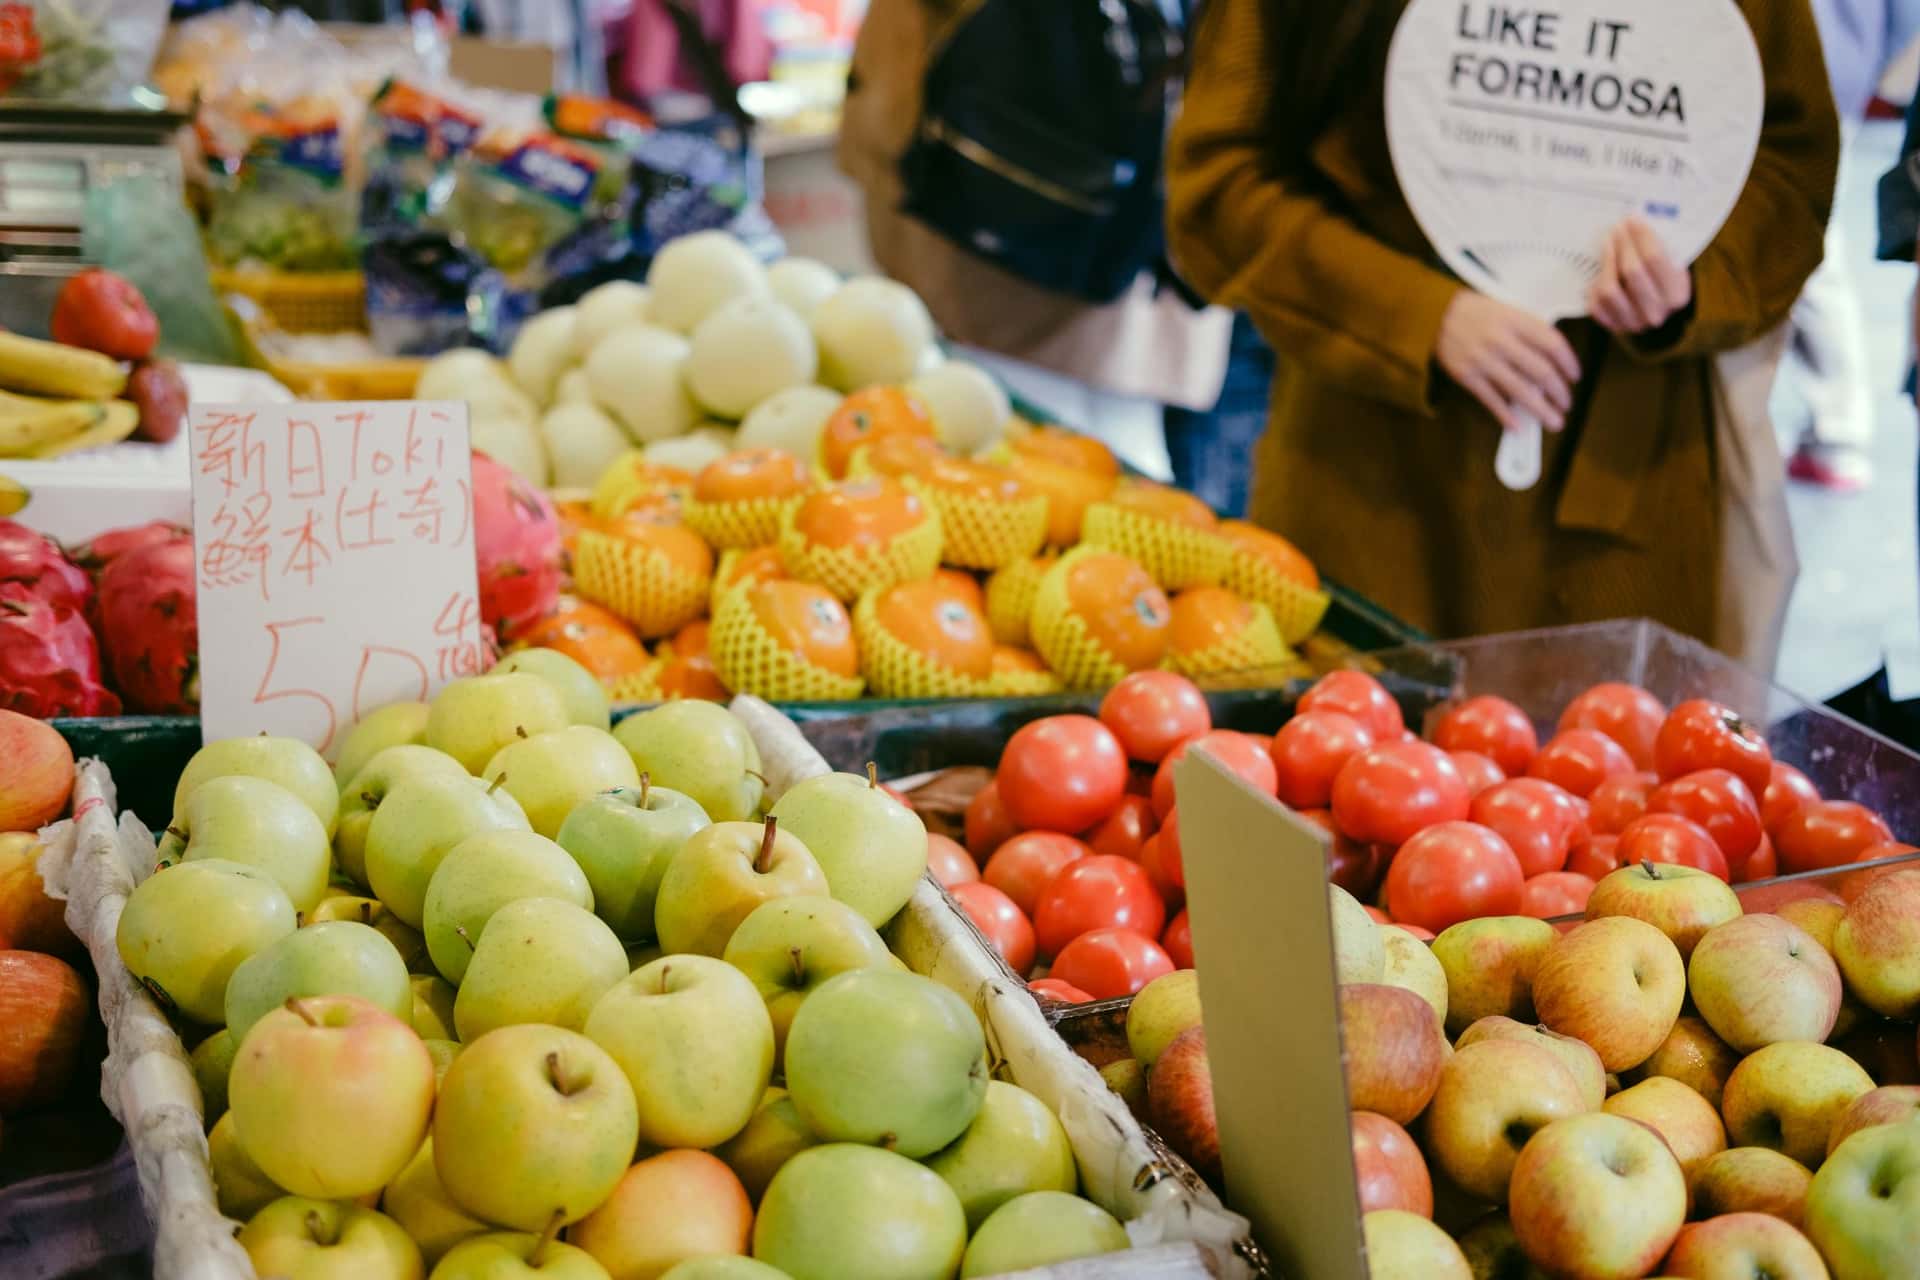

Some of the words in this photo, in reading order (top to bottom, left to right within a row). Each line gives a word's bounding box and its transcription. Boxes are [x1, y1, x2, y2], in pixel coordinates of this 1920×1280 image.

[1456, 2, 1560, 51] LIKE
[1586, 20, 1631, 61] IT
[1449, 53, 1687, 123] FORMOSA
